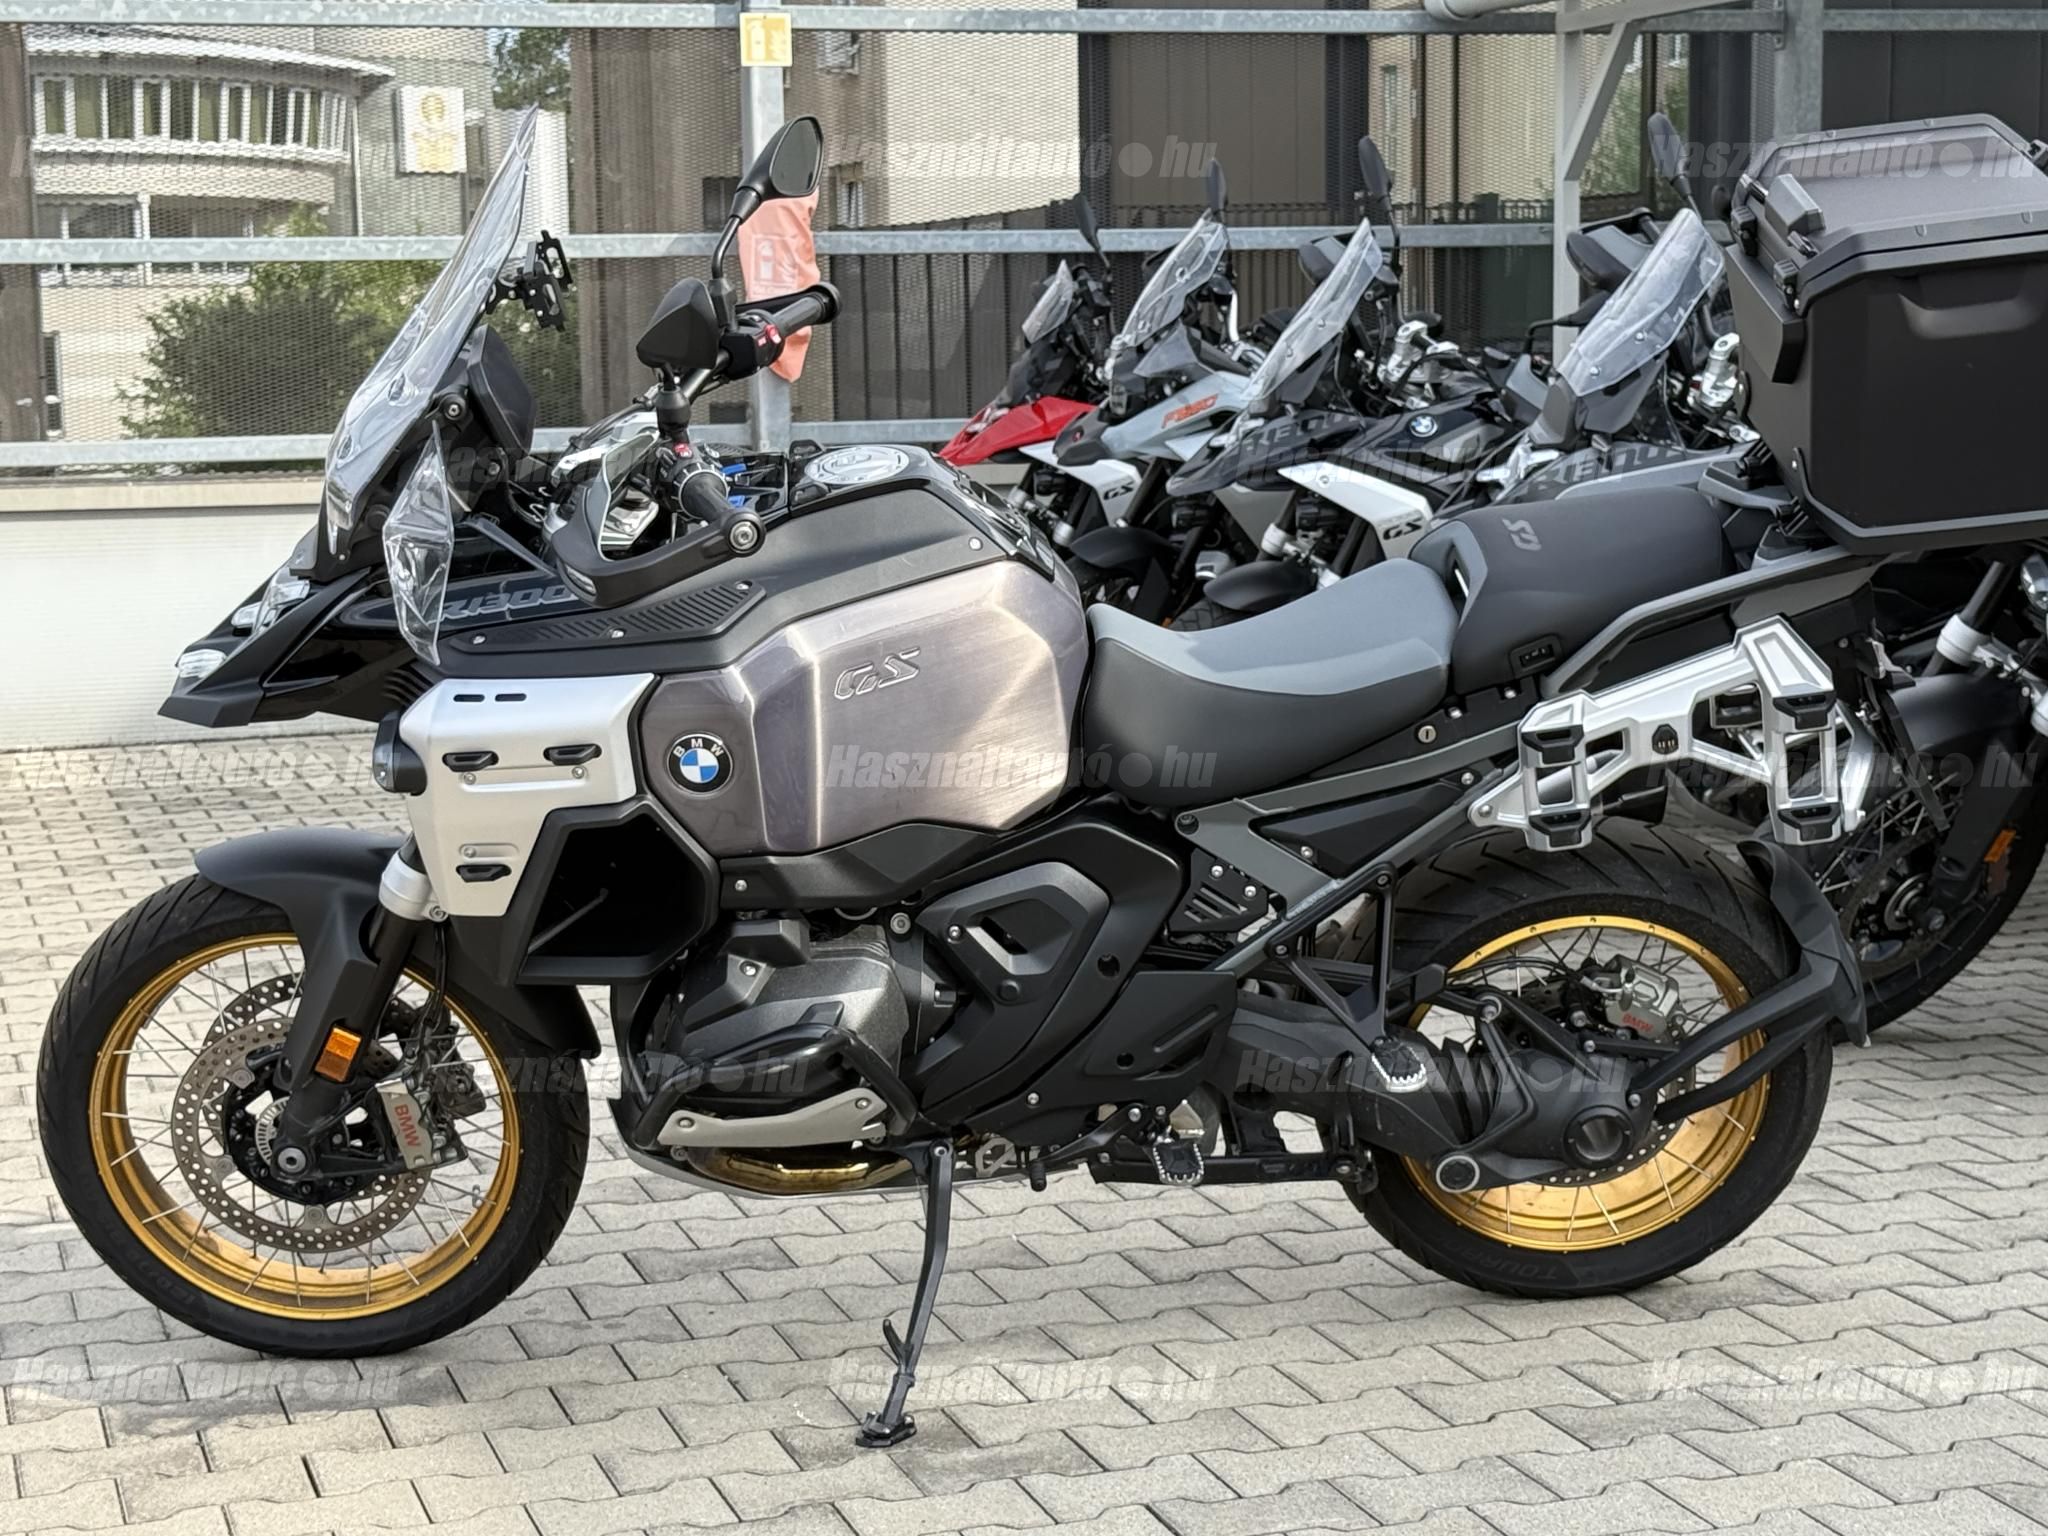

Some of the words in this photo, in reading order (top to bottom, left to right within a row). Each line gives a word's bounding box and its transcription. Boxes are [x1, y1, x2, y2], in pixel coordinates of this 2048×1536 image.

[1383, 516, 1422, 541] GS
[833, 645, 921, 700] GS
[672, 738, 725, 759] BMW
[394, 1104, 421, 1147] BMW
